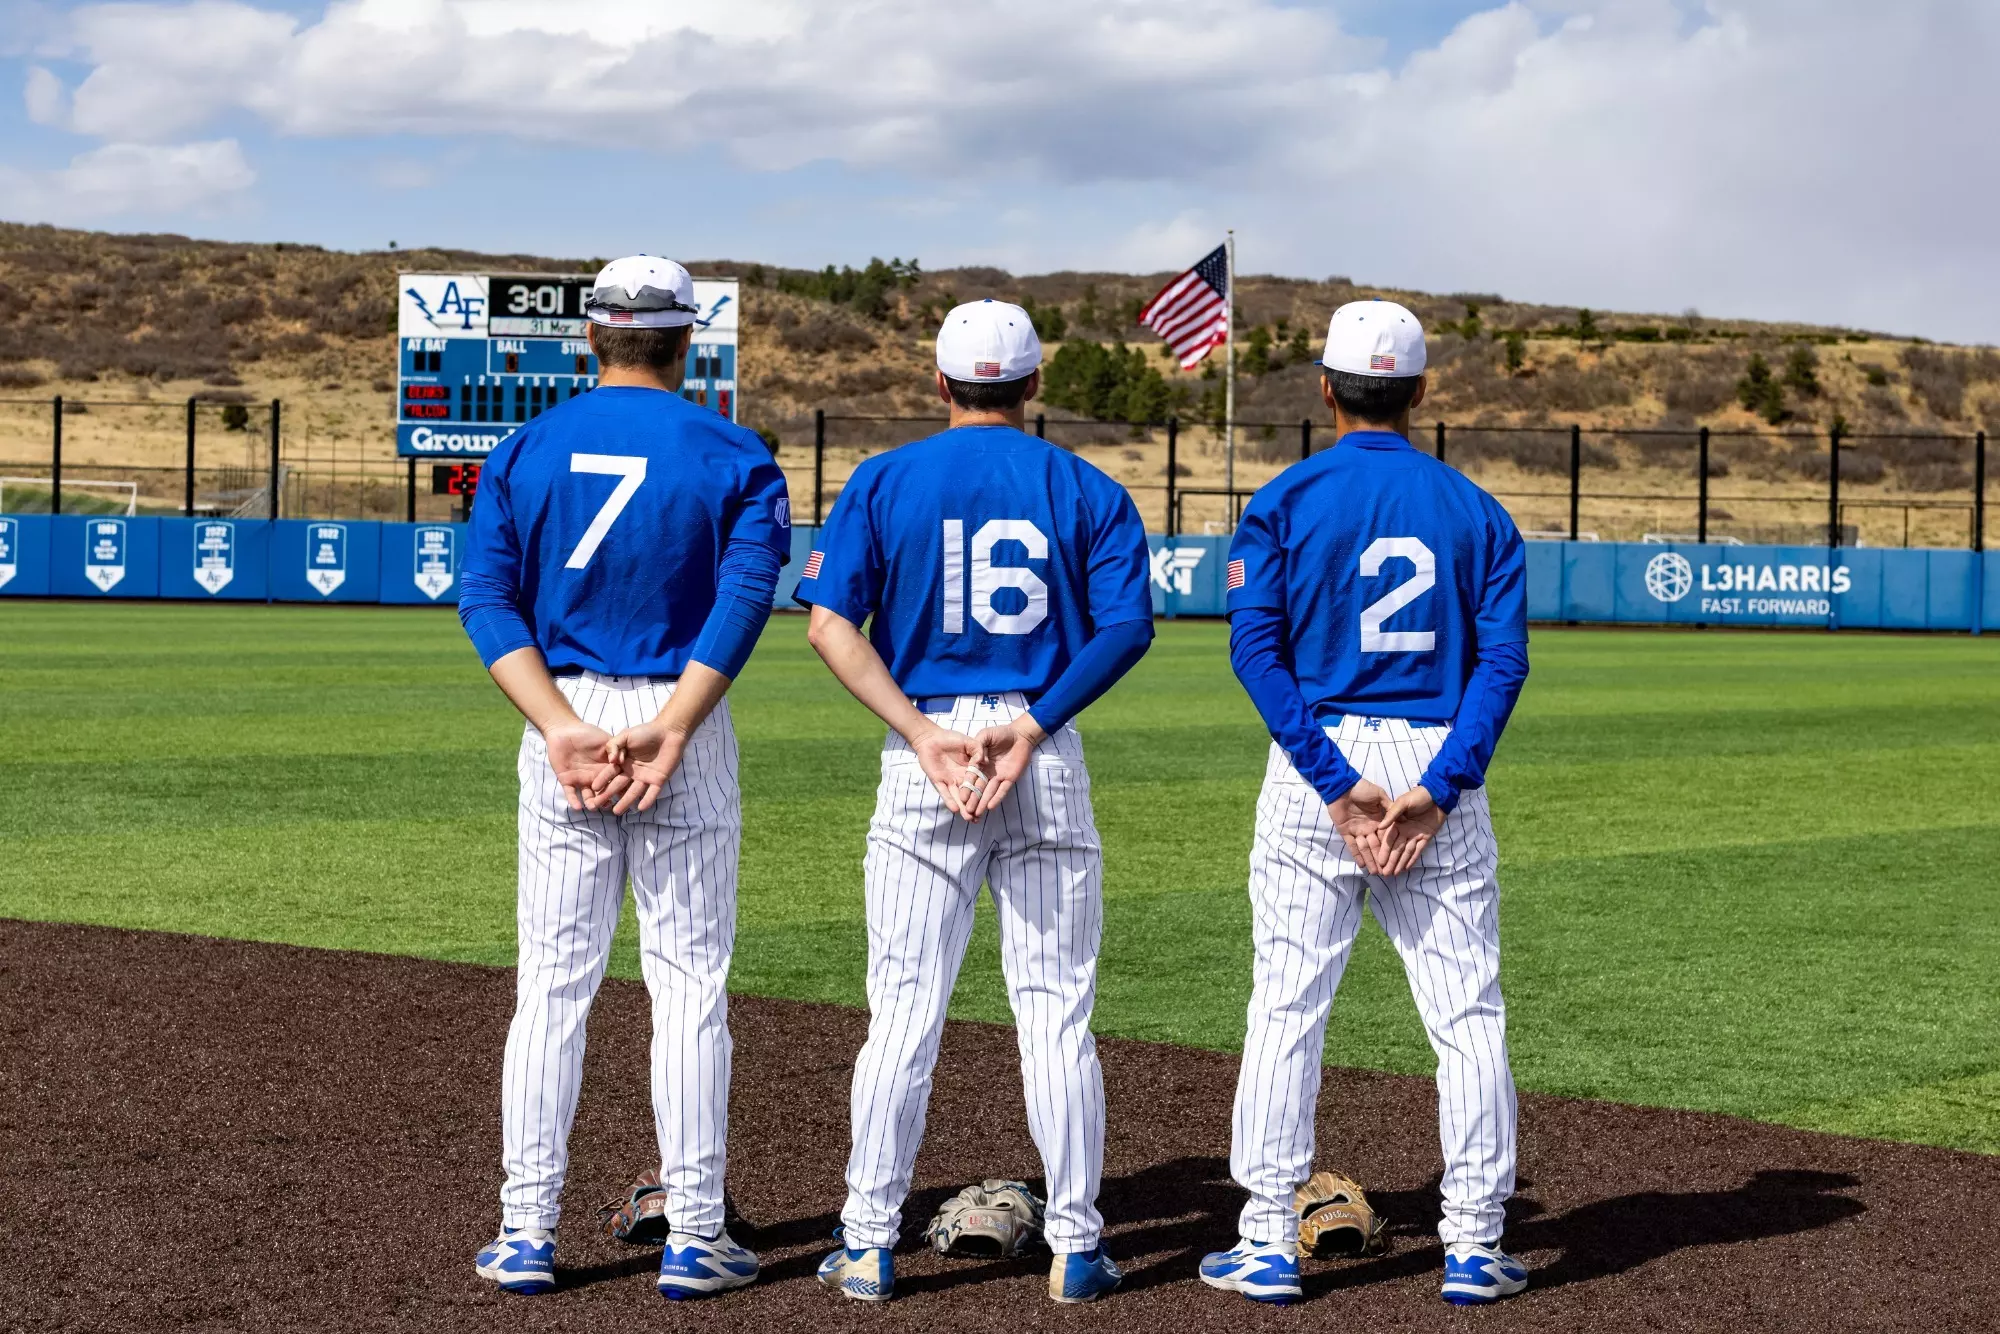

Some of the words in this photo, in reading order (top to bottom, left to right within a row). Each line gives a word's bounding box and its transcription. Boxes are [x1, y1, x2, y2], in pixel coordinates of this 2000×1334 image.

[436, 281, 485, 330] AF
[507, 284, 565, 315] 3:01
[551, 320, 571, 334] Mar
[407, 339, 423, 352] AT
[424, 339, 449, 352] BAT
[496, 340, 528, 353] BALL
[561, 341, 594, 355] STRI
[463, 374, 470, 386] 1
[478, 374, 486, 386] 2
[493, 375, 501, 386] 3
[517, 374, 525, 386] 4
[573, 376, 580, 388] 7
[564, 453, 648, 569] 7
[943, 519, 1048, 634] 16
[1701, 564, 1852, 594] L3HARRIS
[1360, 537, 1435, 652] 2
[1701, 598, 1744, 614] FAST.
[1748, 599, 1836, 618] FORWARD.
